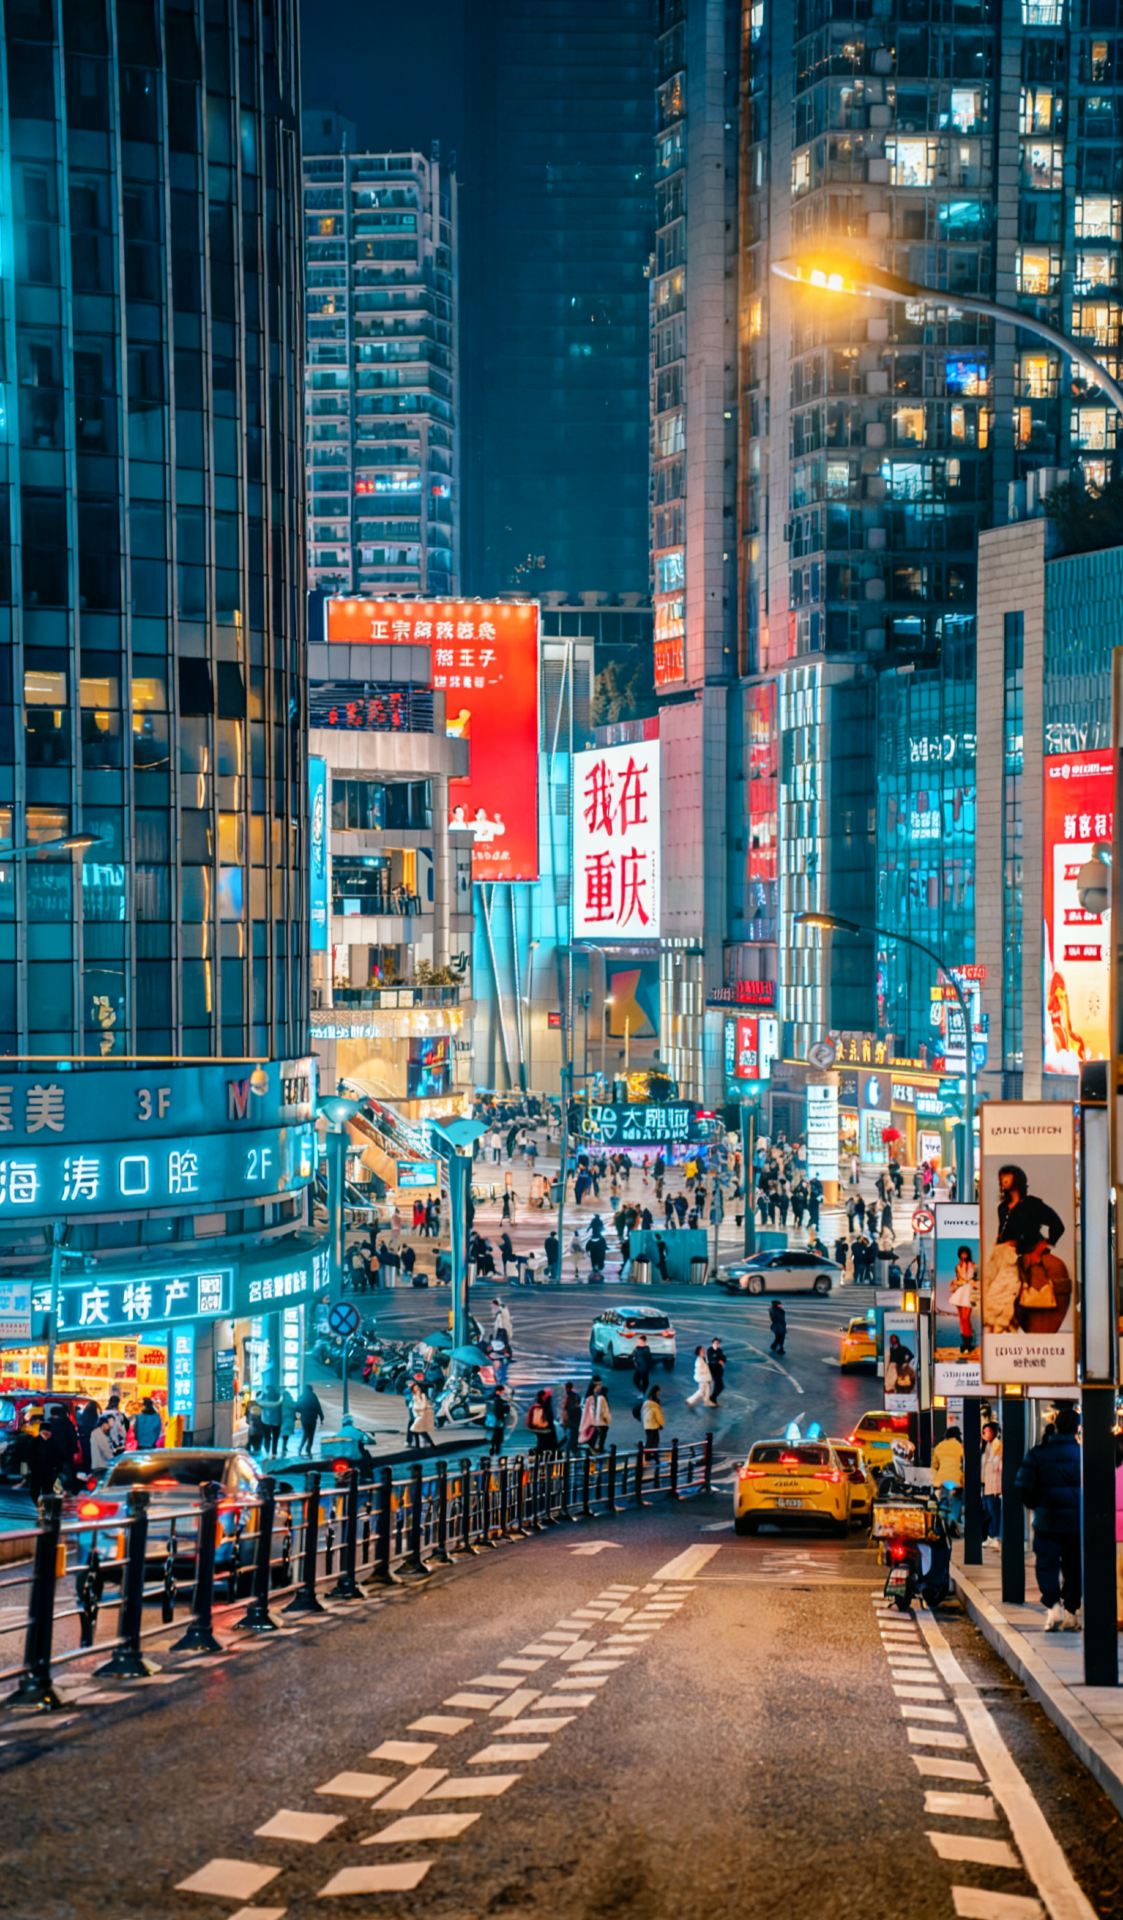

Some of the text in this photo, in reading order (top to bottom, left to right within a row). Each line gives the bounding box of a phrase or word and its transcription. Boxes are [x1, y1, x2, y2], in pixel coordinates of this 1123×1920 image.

[583, 755, 649, 837] 我在
[583, 846, 650, 929] 重庆
[137, 1087, 172, 1121] 3F
[0, 1148, 273, 1205] 海涛口腔 2F
